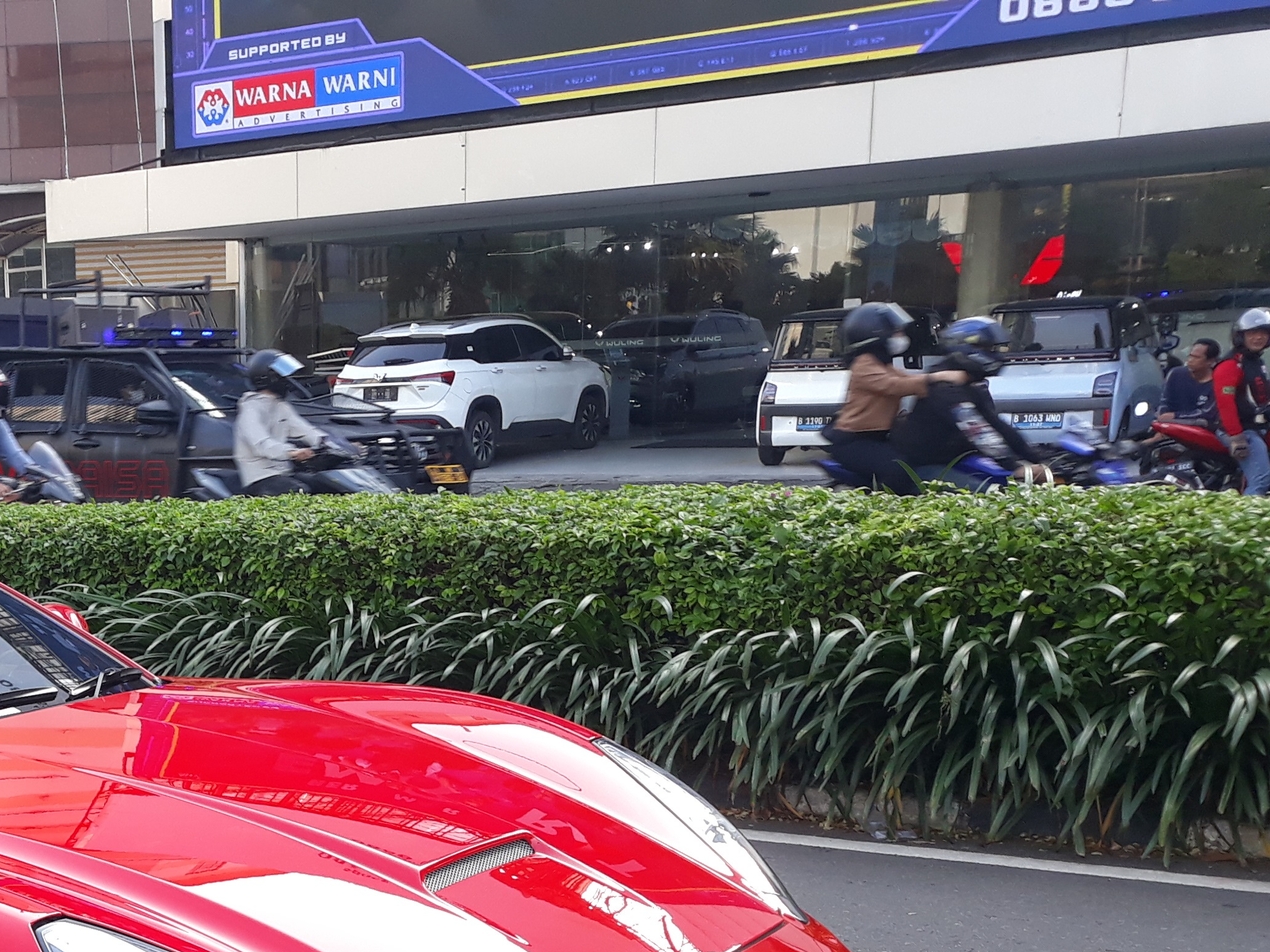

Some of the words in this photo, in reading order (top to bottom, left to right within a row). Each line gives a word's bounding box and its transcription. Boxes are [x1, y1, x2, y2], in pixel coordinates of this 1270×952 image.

[229, 36, 322, 61] SUPPORTED
[325, 32, 346, 46] BY
[235, 79, 312, 108] WARNA
[323, 67, 396, 95] WARNI
[238, 98, 399, 127] ADVERTISING
[1013, 414, 1019, 423] B
